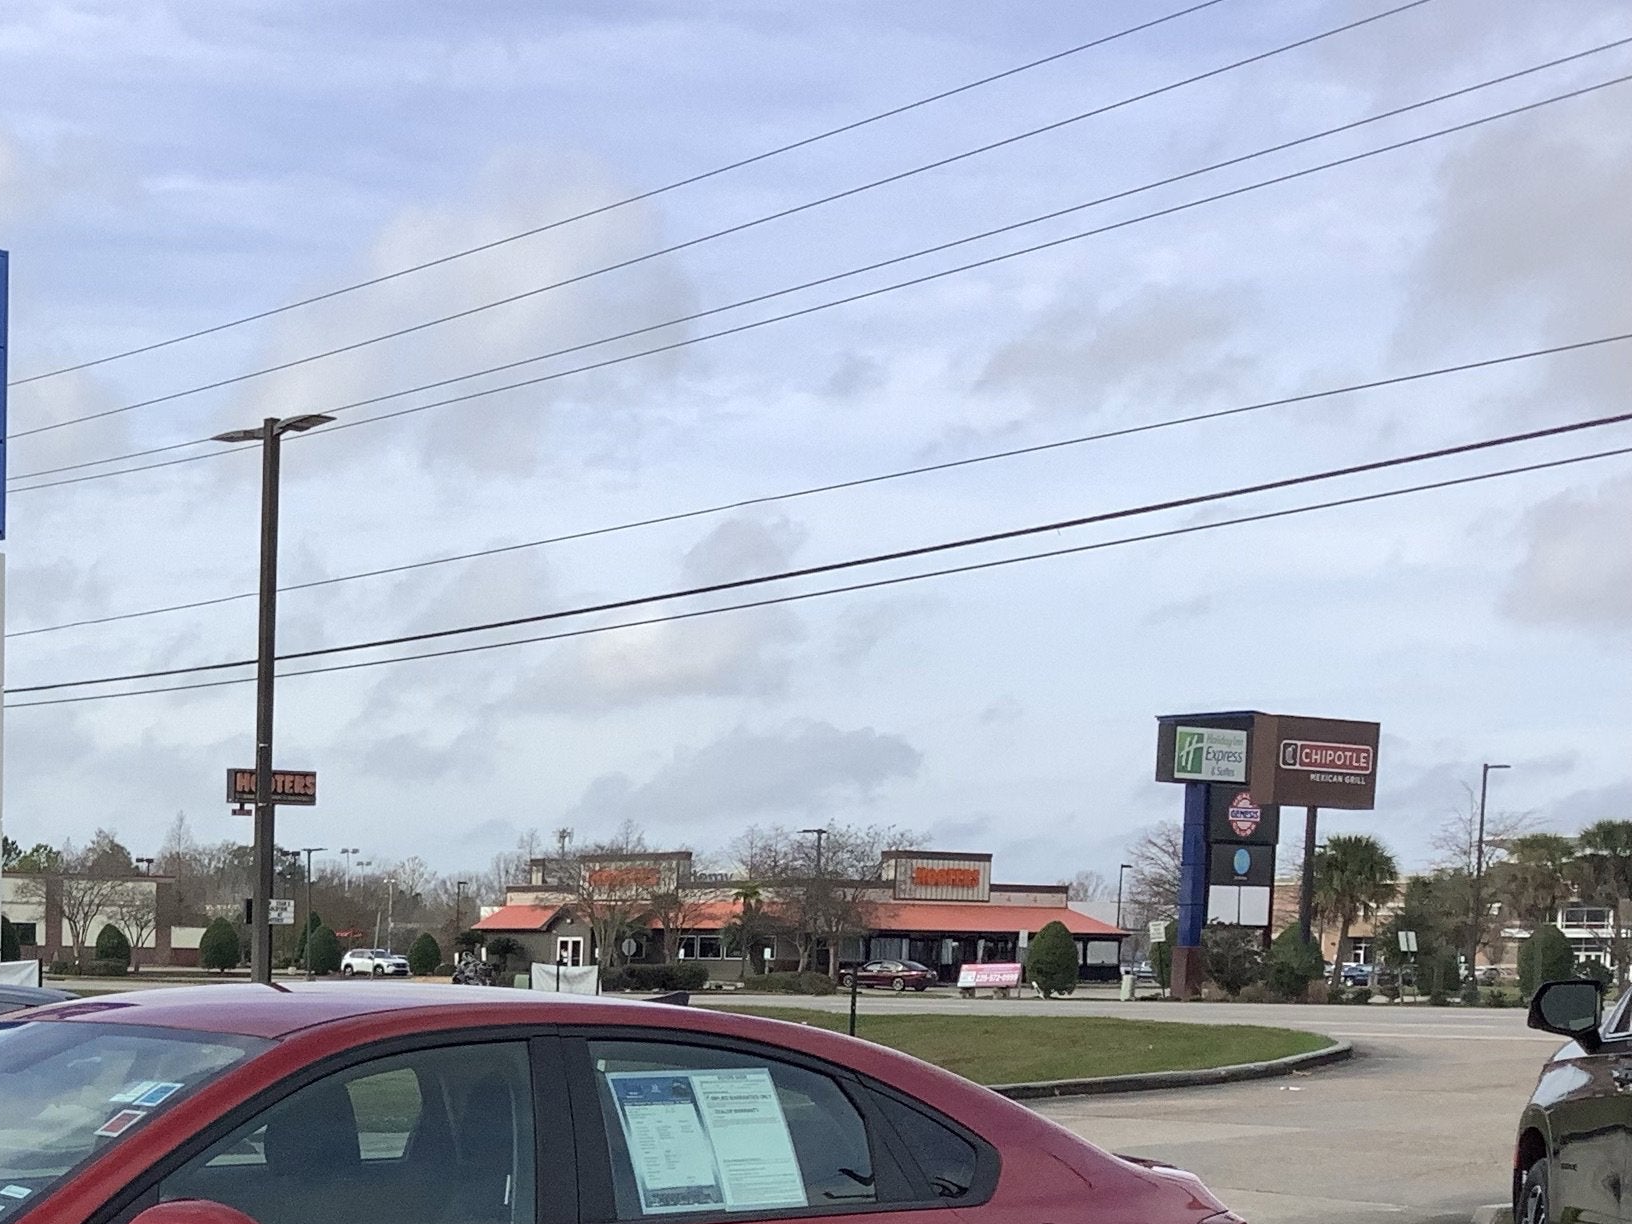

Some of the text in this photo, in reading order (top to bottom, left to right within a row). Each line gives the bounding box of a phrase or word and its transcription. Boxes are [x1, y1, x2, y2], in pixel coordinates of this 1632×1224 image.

[1206, 746, 1243, 764] Express
[1301, 748, 1368, 767] CHIPOTLE
[1310, 773, 1366, 785] MEXICAN GRILL
